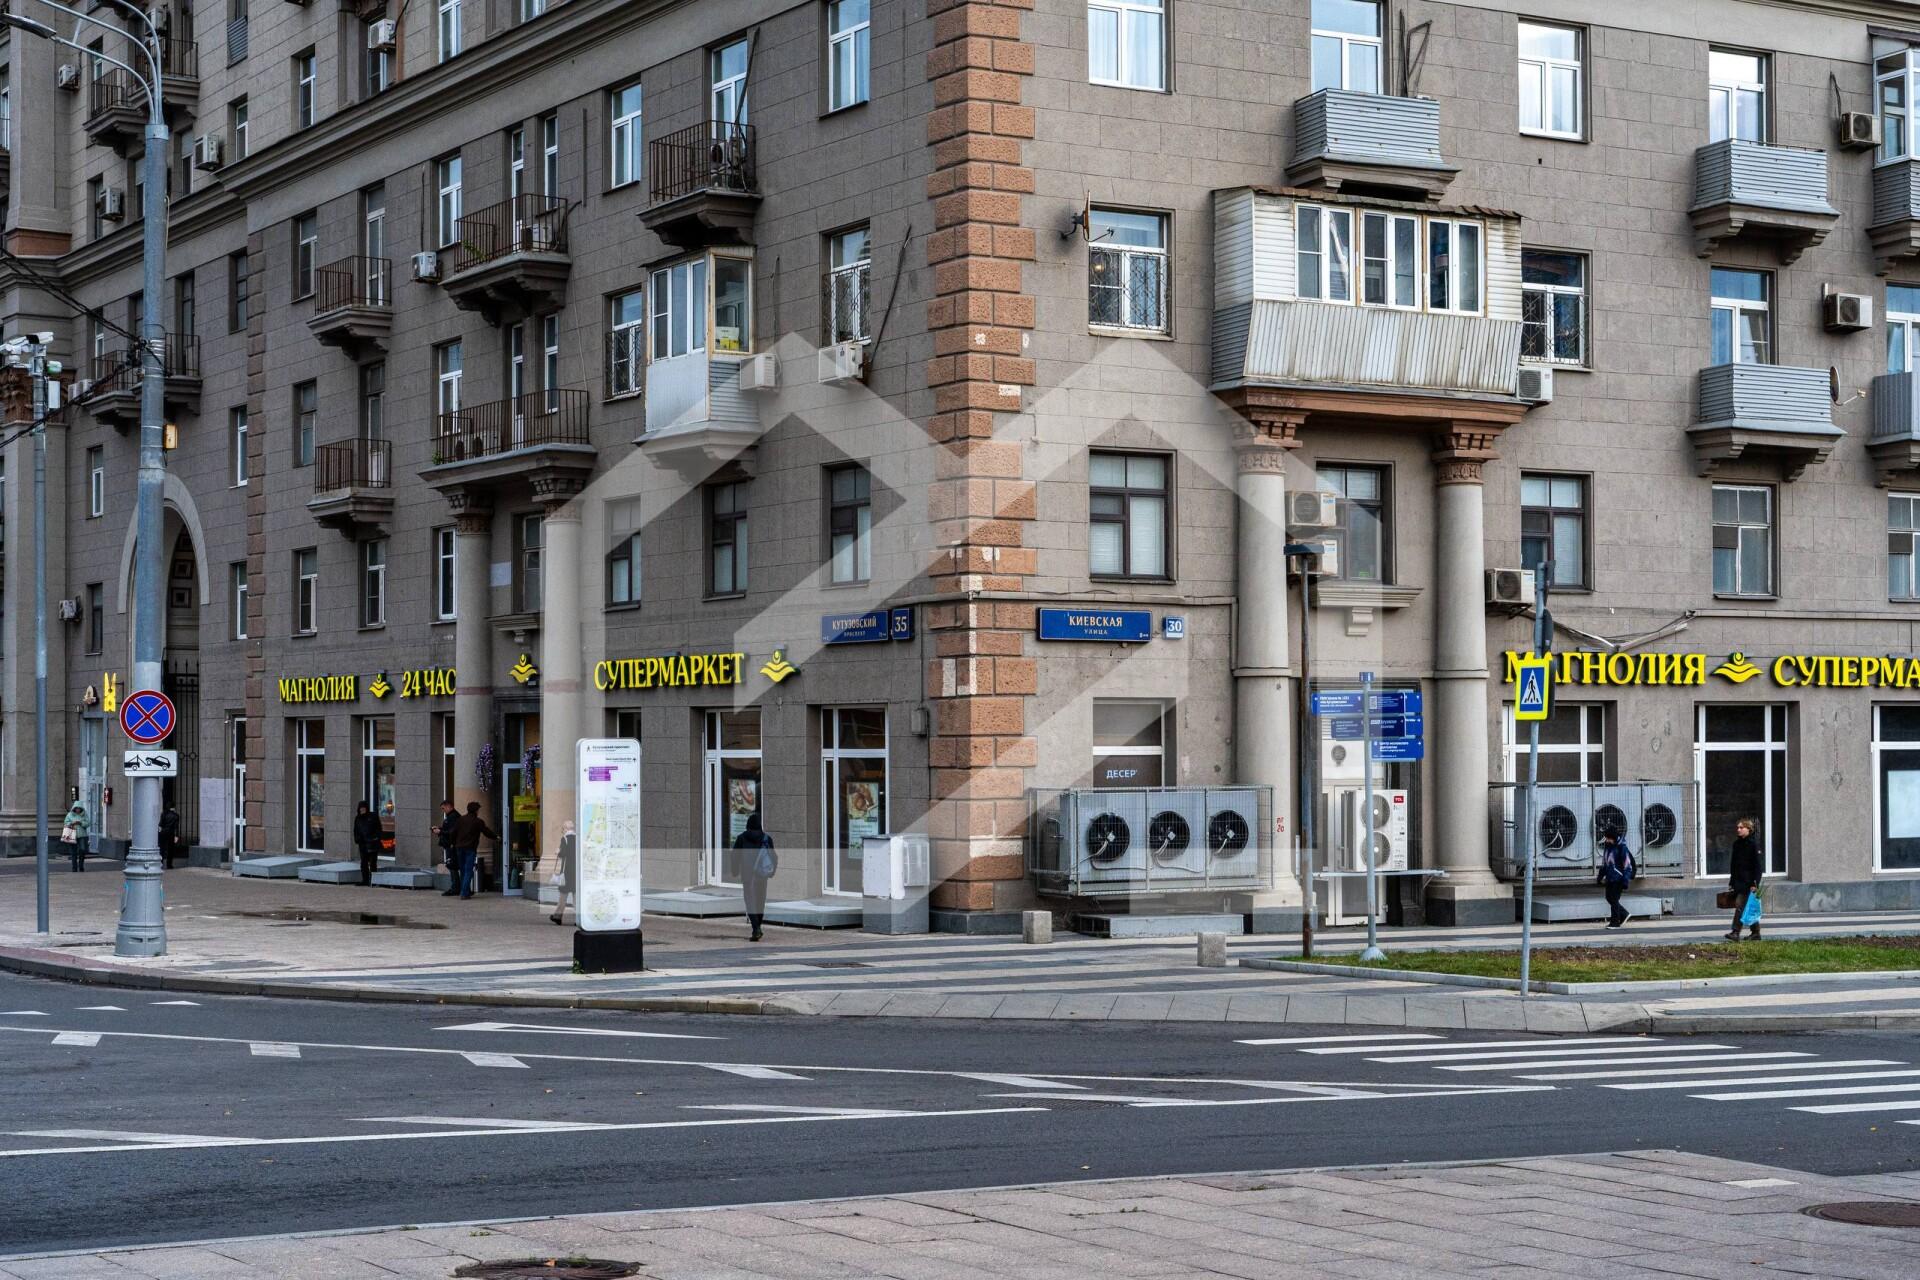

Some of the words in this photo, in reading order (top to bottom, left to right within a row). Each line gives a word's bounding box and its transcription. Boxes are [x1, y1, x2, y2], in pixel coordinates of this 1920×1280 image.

[832, 615, 877, 631] КУТУЗОВСКИЙ
[894, 616, 907, 632] 35
[1069, 615, 1123, 628] КИЕВСКАЯ
[1168, 620, 1182, 632] 30
[594, 652, 745, 691] СУПЕРМАРКЕТ
[279, 675, 355, 702] МАГНОЛИЯ
[402, 671, 421, 697] 24
